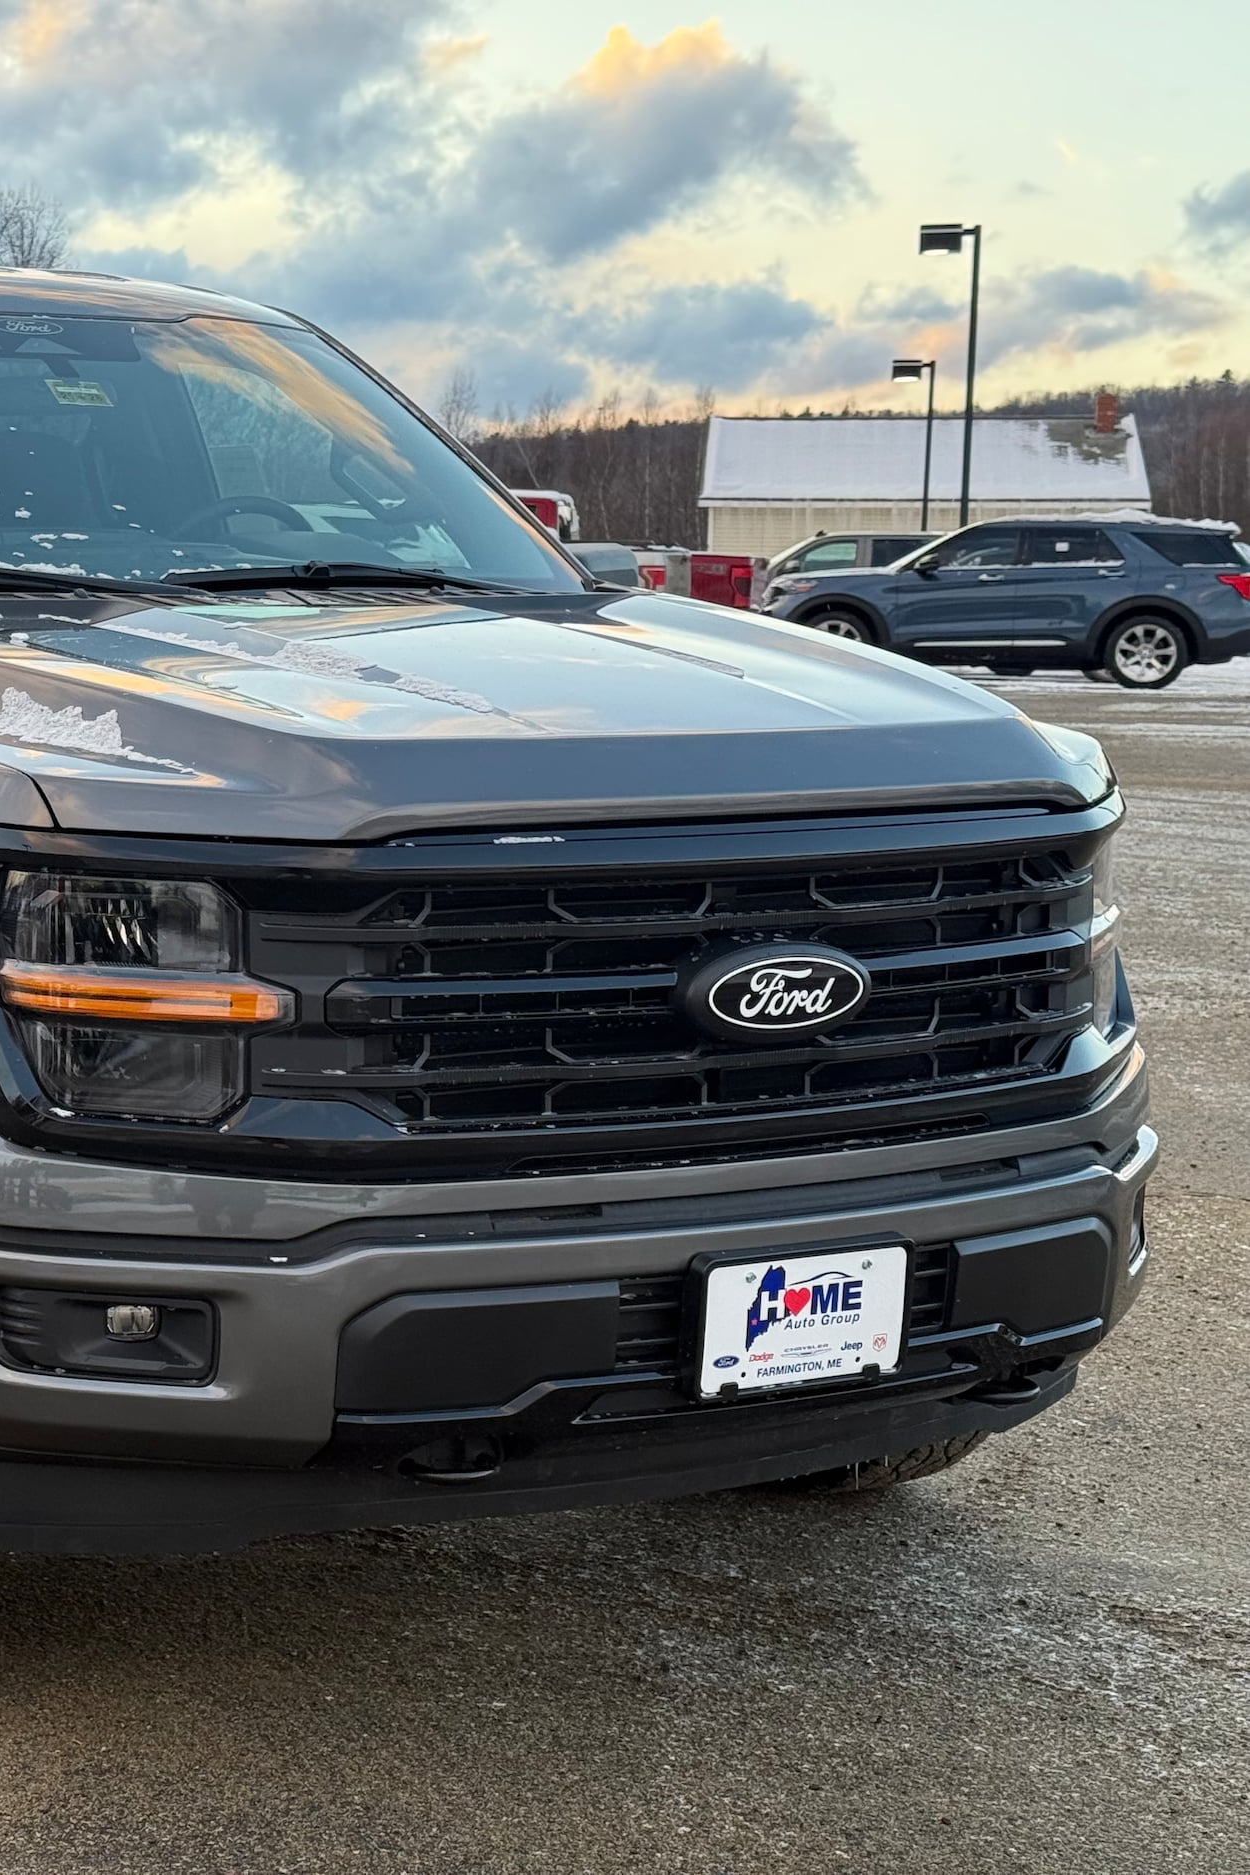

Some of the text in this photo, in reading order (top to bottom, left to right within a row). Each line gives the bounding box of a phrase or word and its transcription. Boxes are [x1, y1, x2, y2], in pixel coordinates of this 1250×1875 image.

[5, 320, 52, 333] Ford
[739, 968, 836, 1018] Ford
[784, 1312, 860, 1331] Auto Group
[784, 1343, 829, 1353] CHRYSLER
[840, 1340, 863, 1351] Jeep
[749, 1352, 774, 1362] Dodge
[756, 1358, 843, 1378] FARMINGTON, ME
